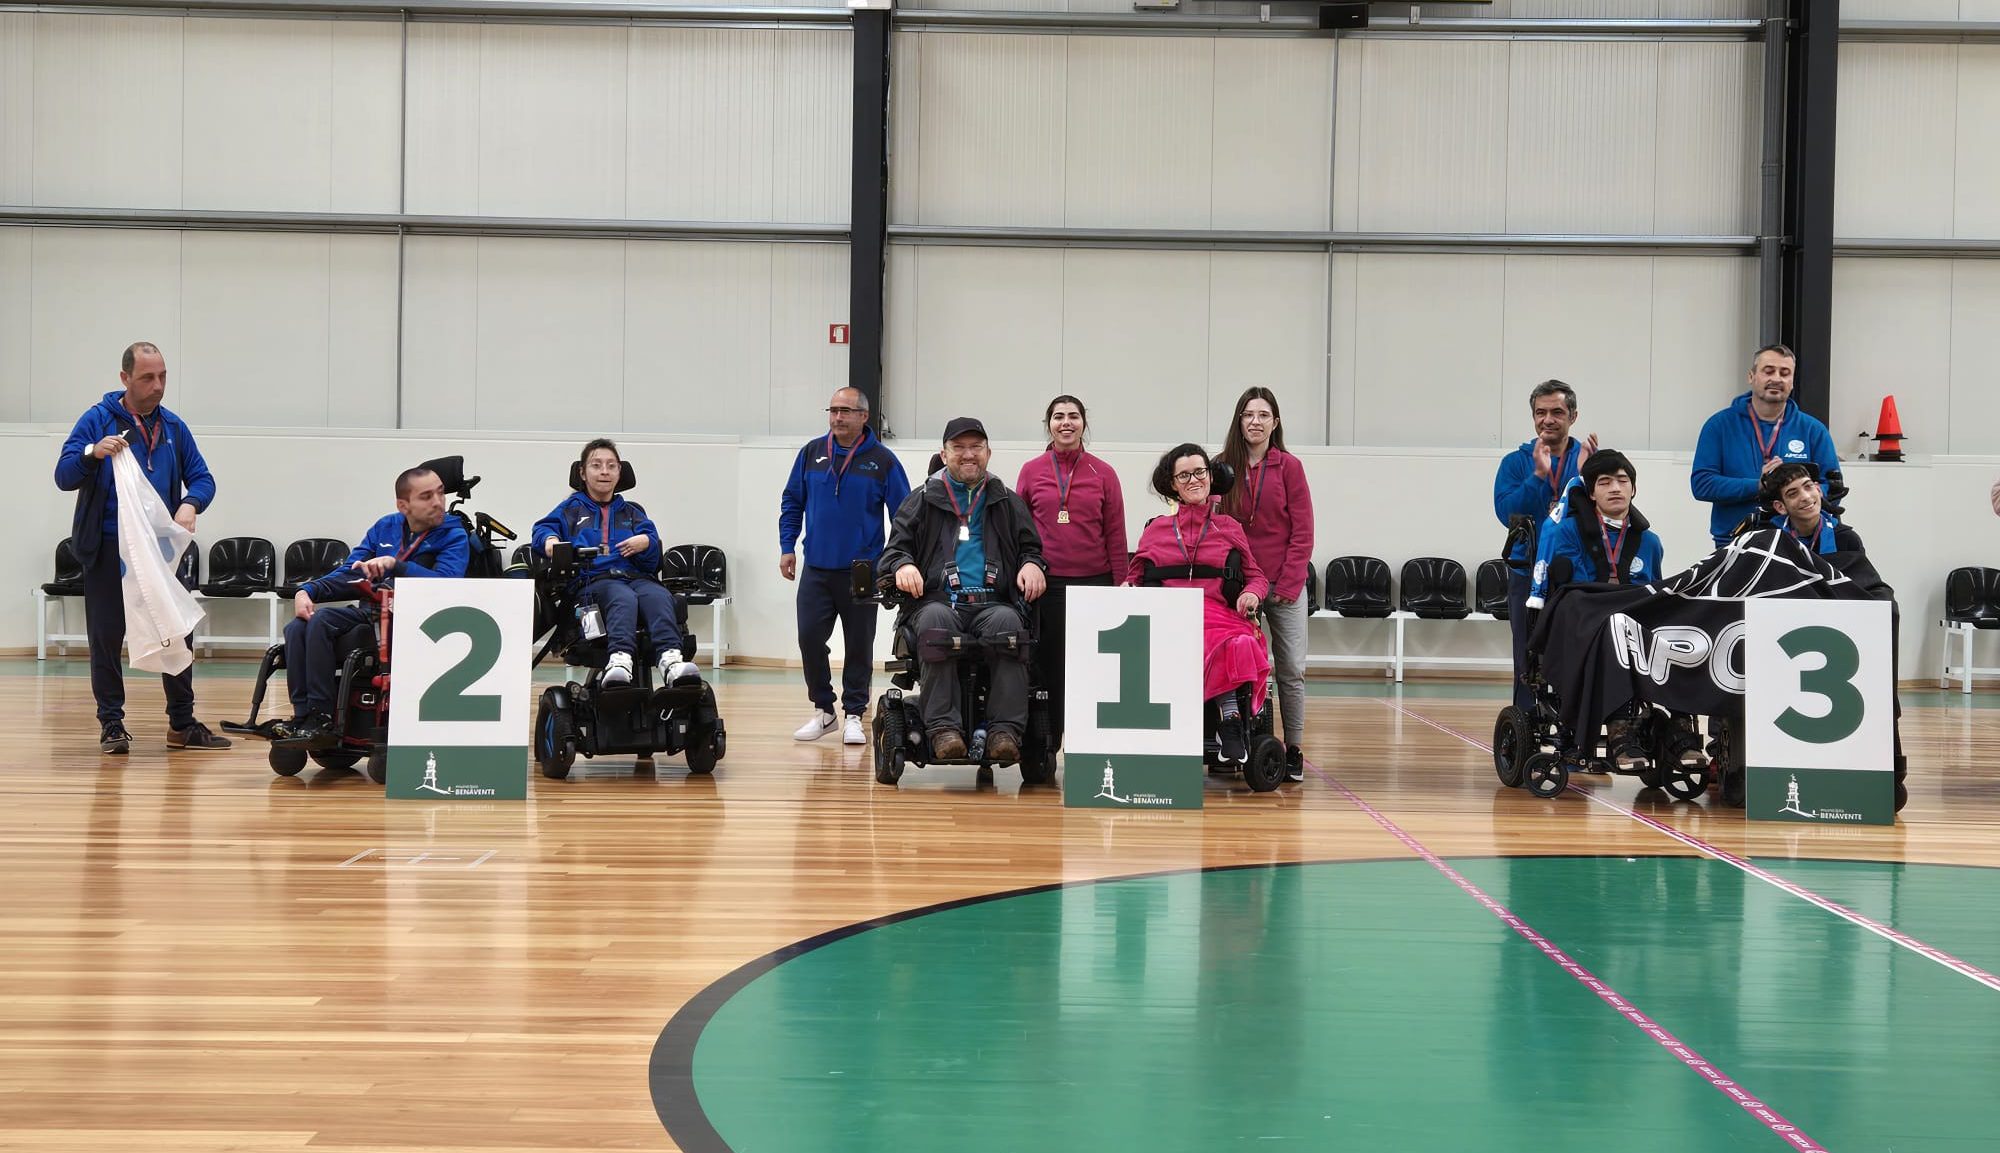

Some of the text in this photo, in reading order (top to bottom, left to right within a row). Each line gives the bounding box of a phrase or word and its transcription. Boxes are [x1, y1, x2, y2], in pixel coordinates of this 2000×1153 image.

[418, 606, 503, 721] 2
[1097, 615, 1171, 730] 1
[1773, 625, 1865, 744] 3
[455, 788, 495, 796] BENAVENTE
[1133, 797, 1173, 805] BENAVENTE
[1820, 812, 1862, 821] BENAVENTE
